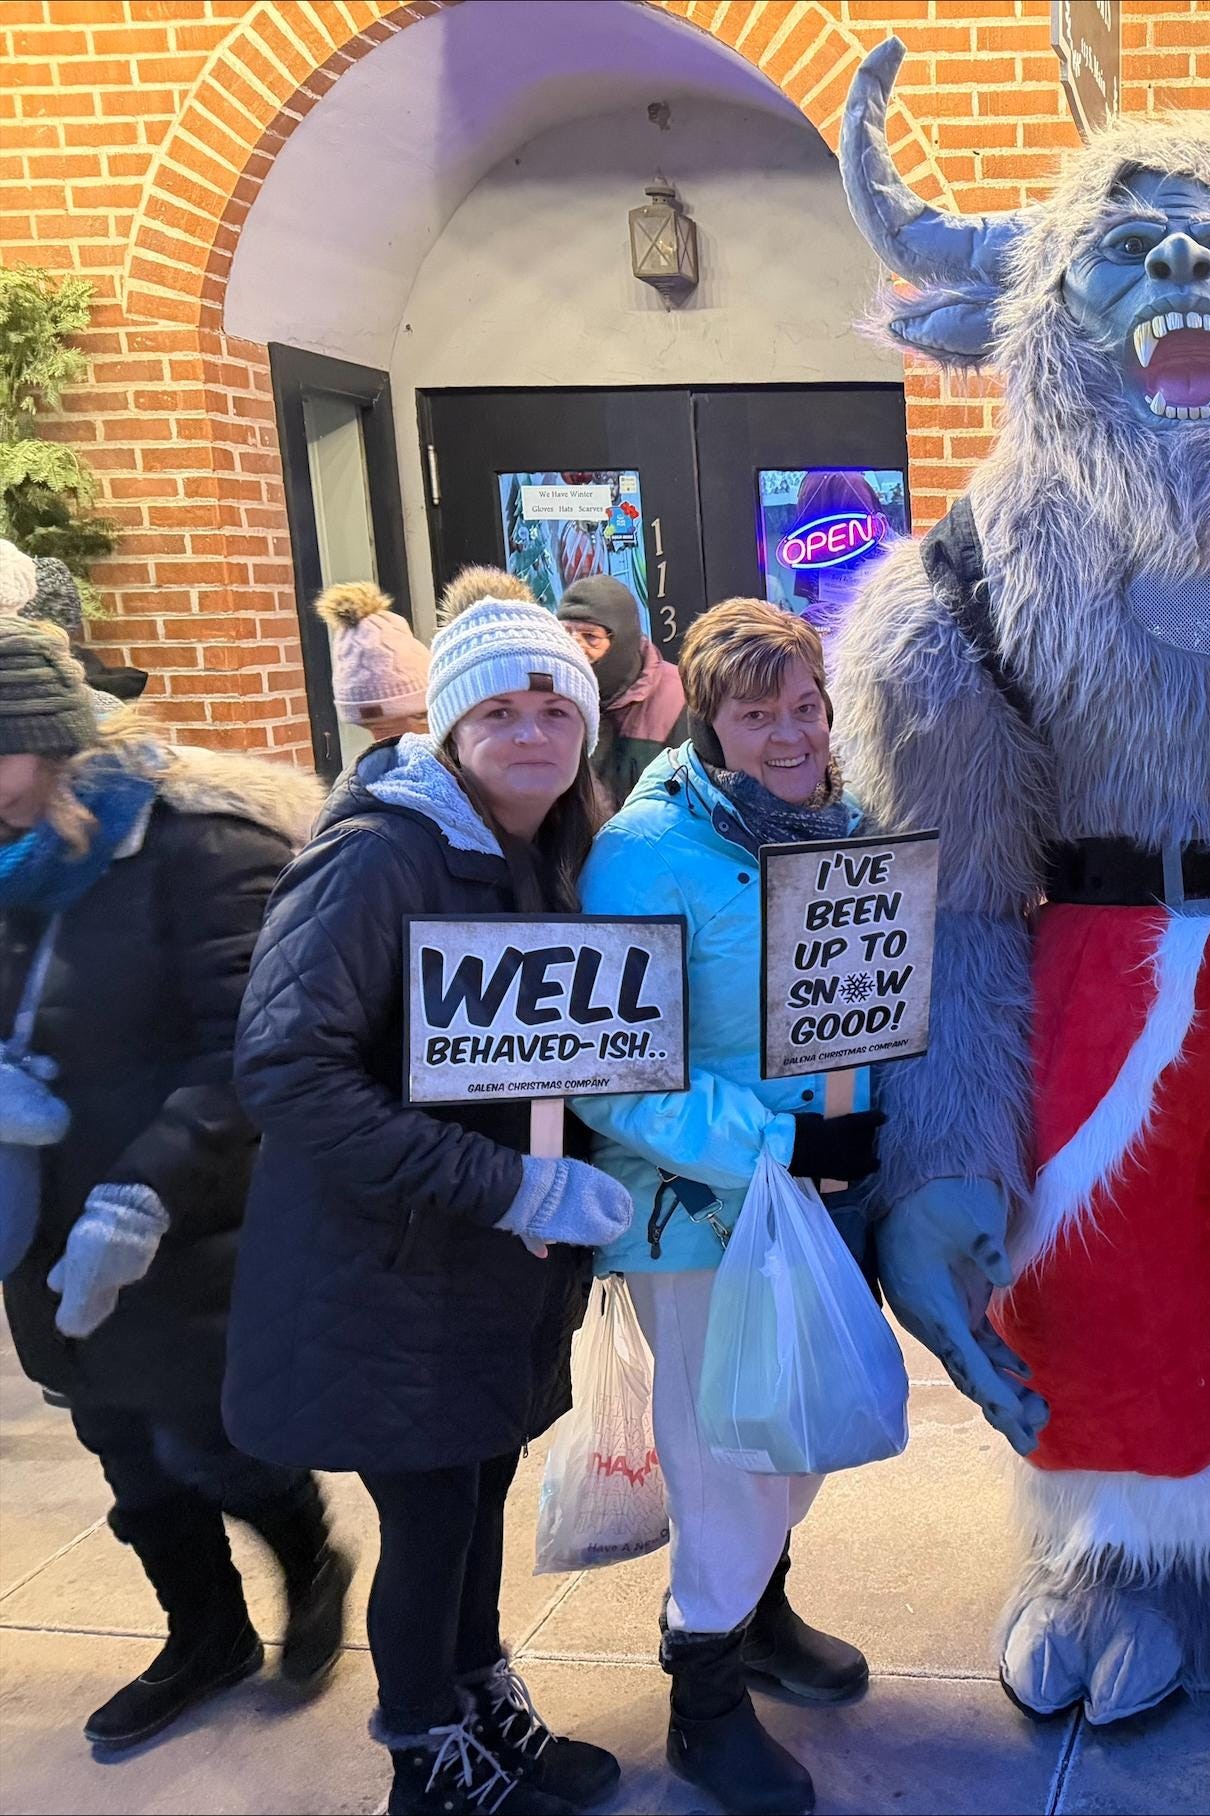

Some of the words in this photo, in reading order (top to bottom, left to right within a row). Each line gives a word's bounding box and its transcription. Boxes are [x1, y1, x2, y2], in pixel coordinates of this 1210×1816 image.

[531, 505, 554, 513] Gloves
[558, 505, 573, 513] Hats
[578, 505, 603, 513] Scarves
[539, 490, 550, 498] We
[551, 490, 568, 498] Have
[570, 490, 593, 498] Winter
[782, 515, 872, 565] OPEN
[817, 853, 893, 891] I'VE
[805, 892, 902, 931] BEEN
[794, 938, 848, 970] UP
[859, 930, 908, 962] TO
[421, 946, 661, 1028] WELL
[790, 1001, 906, 1045] GOOD!
[783, 1054, 816, 1066] GALENA
[818, 1047, 867, 1062] CHRISTMAS
[868, 1039, 909, 1053] COMPANY
[467, 1083, 505, 1093] GALENA
[507, 1081, 562, 1091] CHRISTMAS
[564, 1078, 610, 1089] COMPANY
